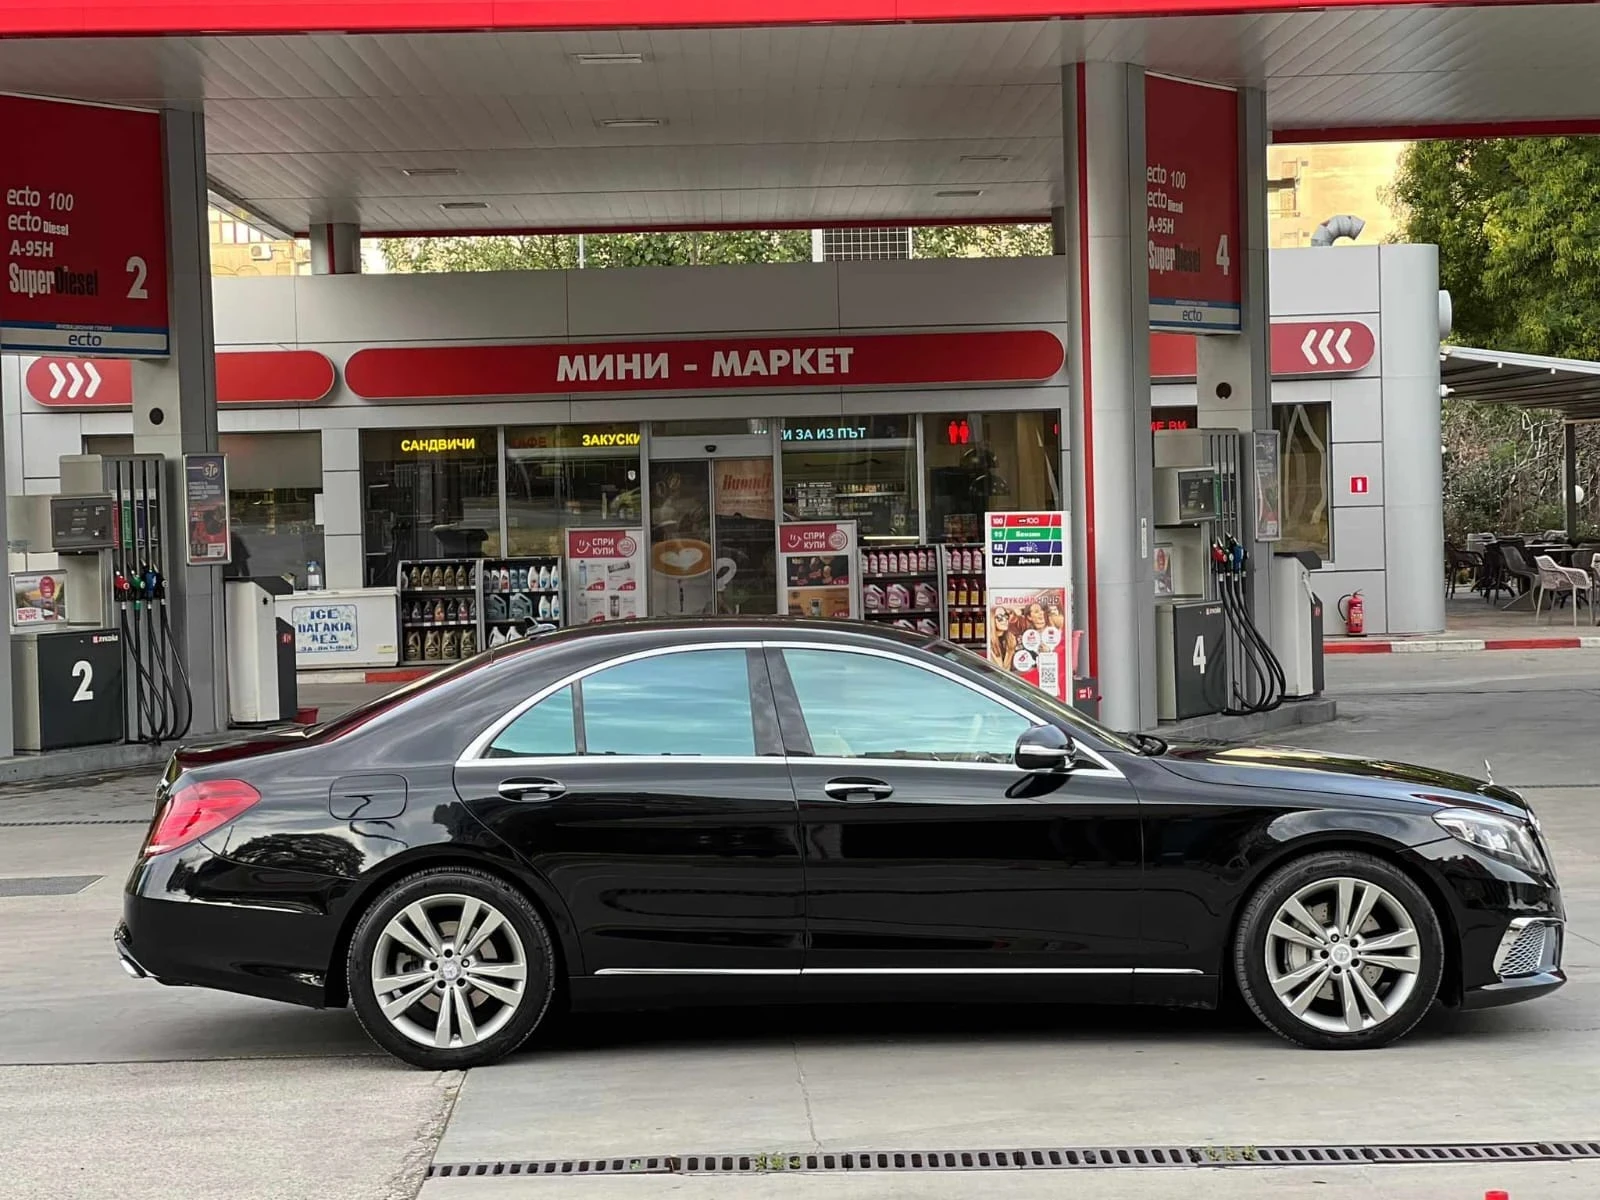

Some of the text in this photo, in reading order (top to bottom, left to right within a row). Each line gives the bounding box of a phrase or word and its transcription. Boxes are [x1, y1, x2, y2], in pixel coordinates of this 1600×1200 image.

[1147, 164, 1185, 189] ecto 100
[7, 186, 73, 211] ecto 100
[1147, 189, 1167, 208] ecto
[8, 211, 69, 236] ecto Diesel
[1148, 216, 1174, 234] A-95H
[9, 239, 54, 257] A-95H
[1216, 234, 1229, 275] 4
[126, 256, 148, 299] 2
[1182, 308, 1202, 322] ecto
[68, 333, 101, 347] ecto
[556, 352, 669, 382] МИНИ
[712, 347, 854, 377] МАРКЕТ
[795, 429, 813, 440] ЗА
[817, 428, 834, 439] ИЗ
[838, 427, 866, 439] ПЪТ
[401, 438, 475, 452] САНДВИЧИ
[204, 463, 218, 477] STP
[592, 538, 614, 546] СПРИ
[803, 532, 825, 540] СПРИ
[804, 541, 826, 549] КУПИ
[593, 547, 614, 555] КУПИ
[310, 609, 338, 619] ICE
[1192, 635, 1206, 674] 4
[72, 660, 94, 702] 2
